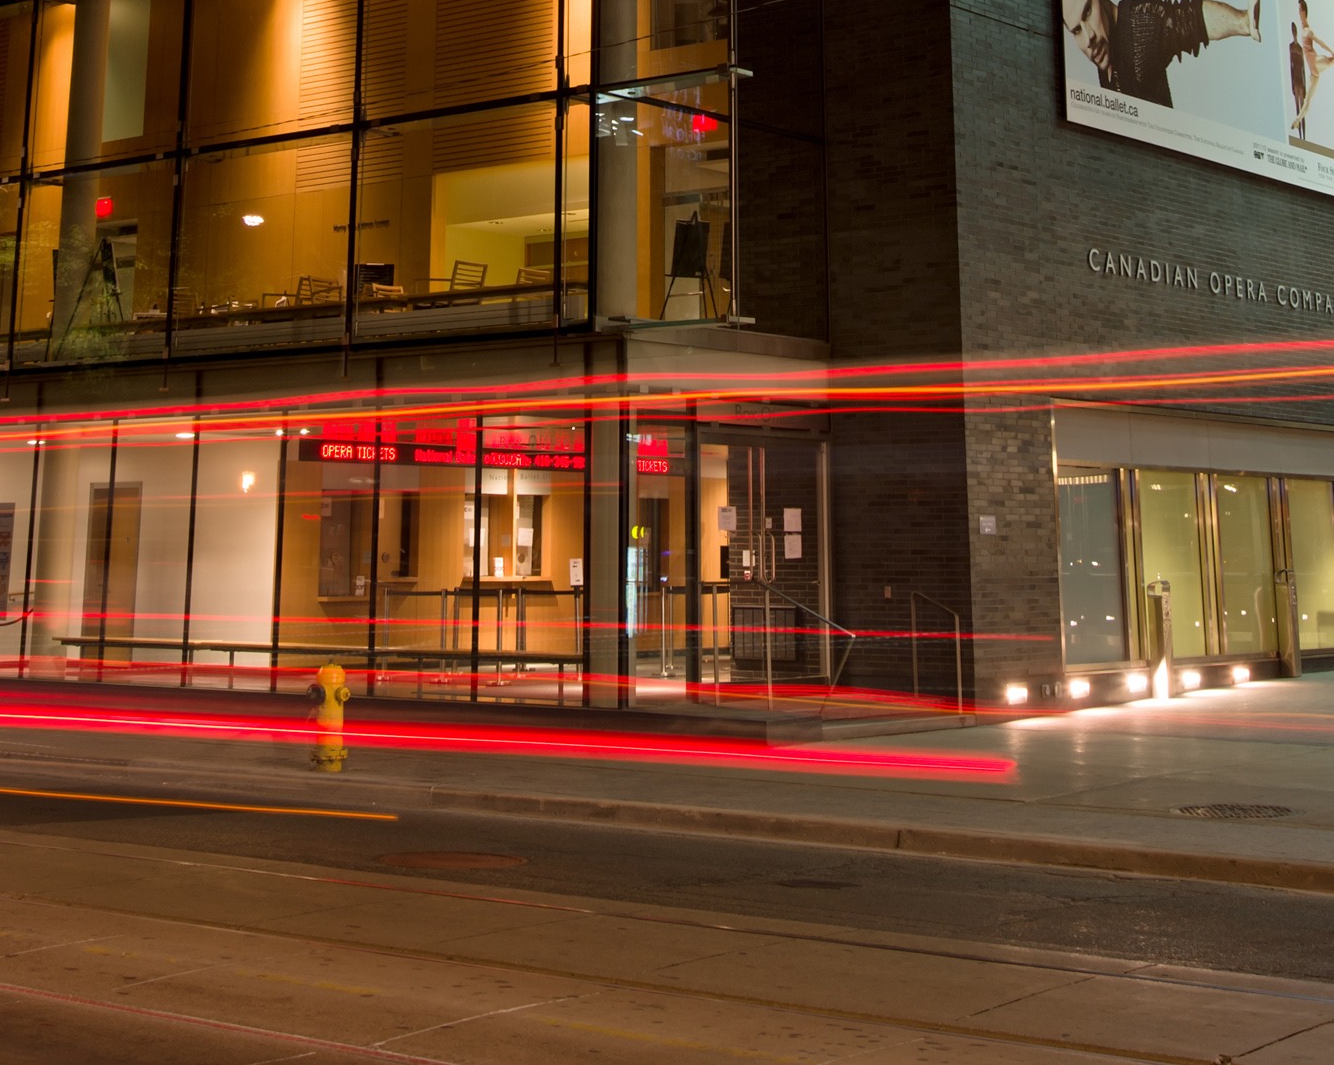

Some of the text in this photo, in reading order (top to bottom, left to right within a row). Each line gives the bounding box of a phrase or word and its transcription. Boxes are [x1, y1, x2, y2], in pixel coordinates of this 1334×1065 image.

[1070, 87, 1140, 118] national.ballet.ca
[1088, 248, 1198, 289] CANADIAN
[1210, 271, 1267, 302] OPERA
[323, 444, 353, 458] OPERA
[637, 460, 668, 473] TICKETS
